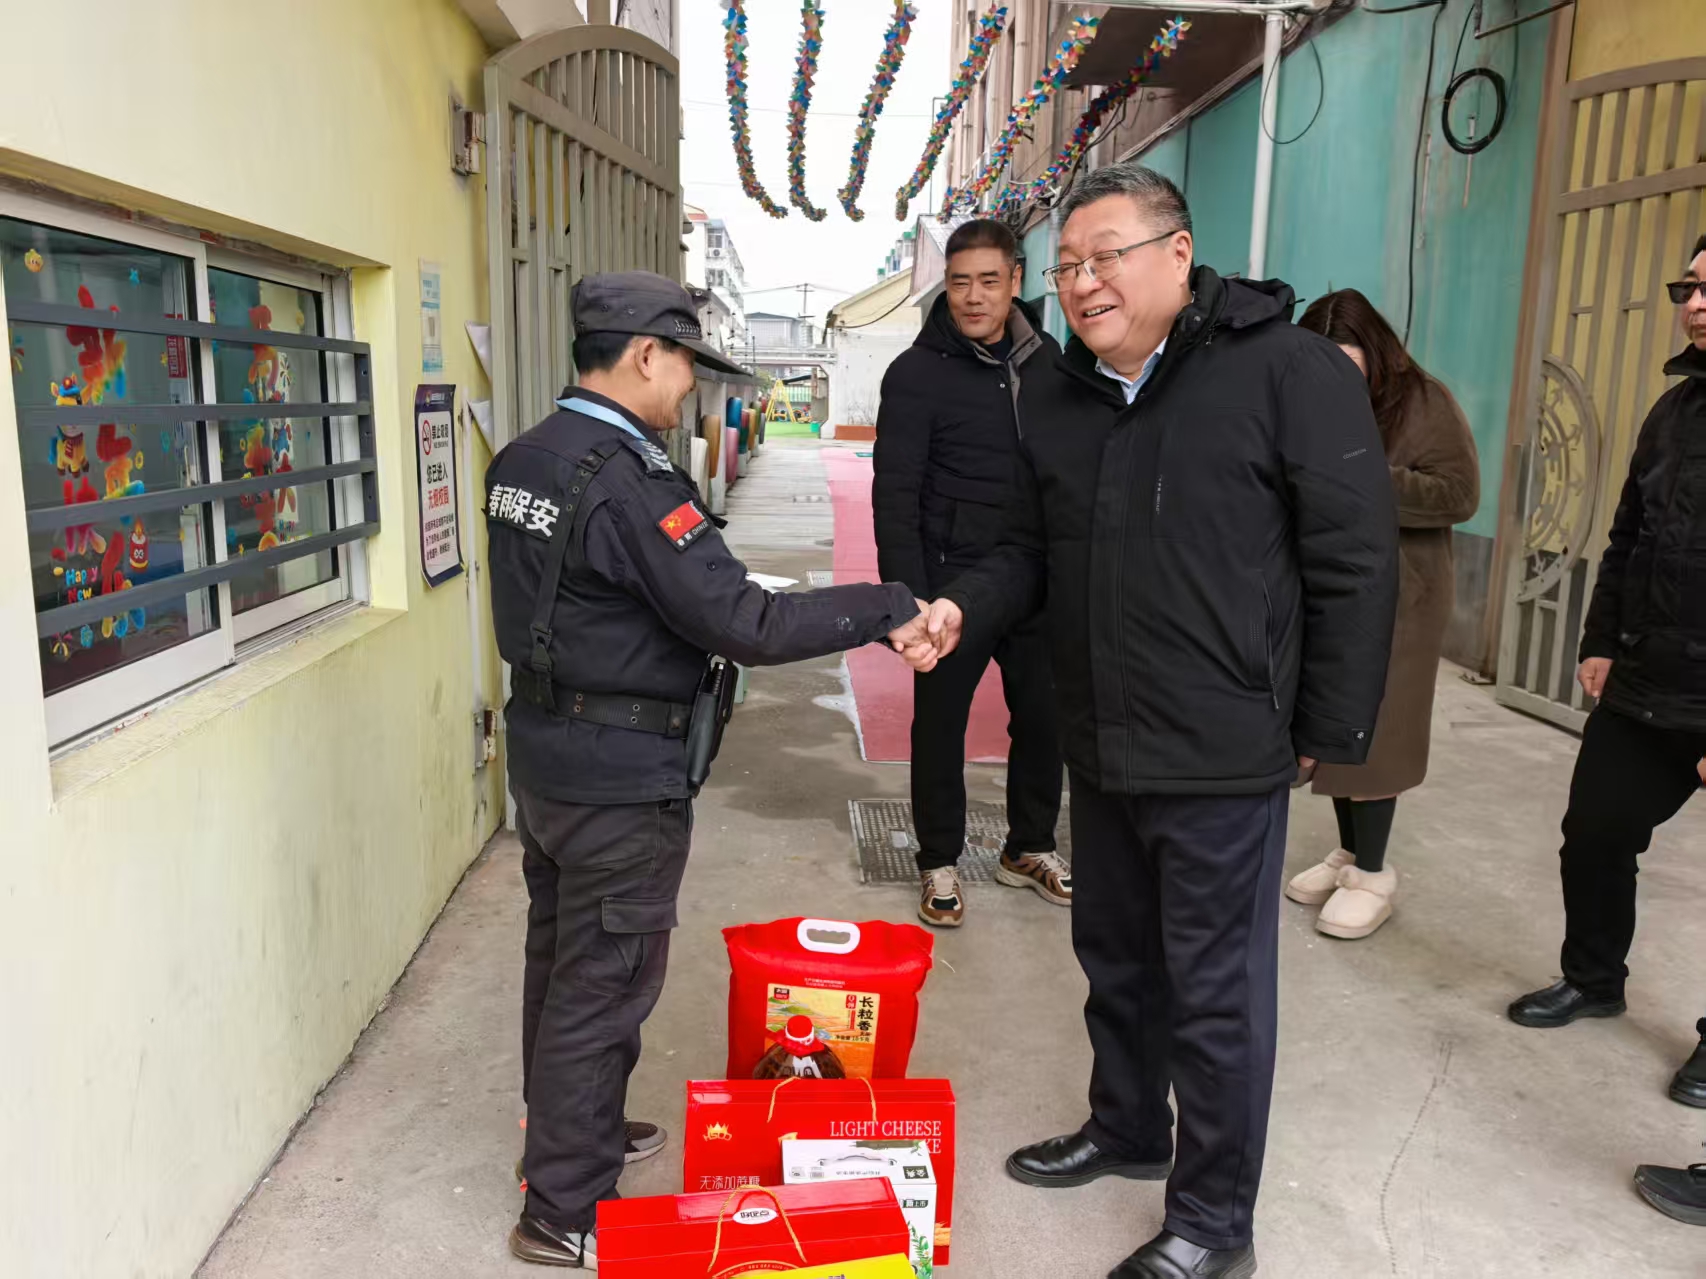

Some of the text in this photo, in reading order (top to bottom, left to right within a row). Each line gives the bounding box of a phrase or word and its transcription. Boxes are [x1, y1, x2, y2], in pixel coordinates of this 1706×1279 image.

[488, 483, 560, 538] 春雨保安
[65, 566, 98, 587] Happy
[857, 996, 874, 1031] 长粒香
[830, 1120, 942, 1137] LIGHT CHEESE
[700, 1175, 760, 1190] 无添加蔗糖
